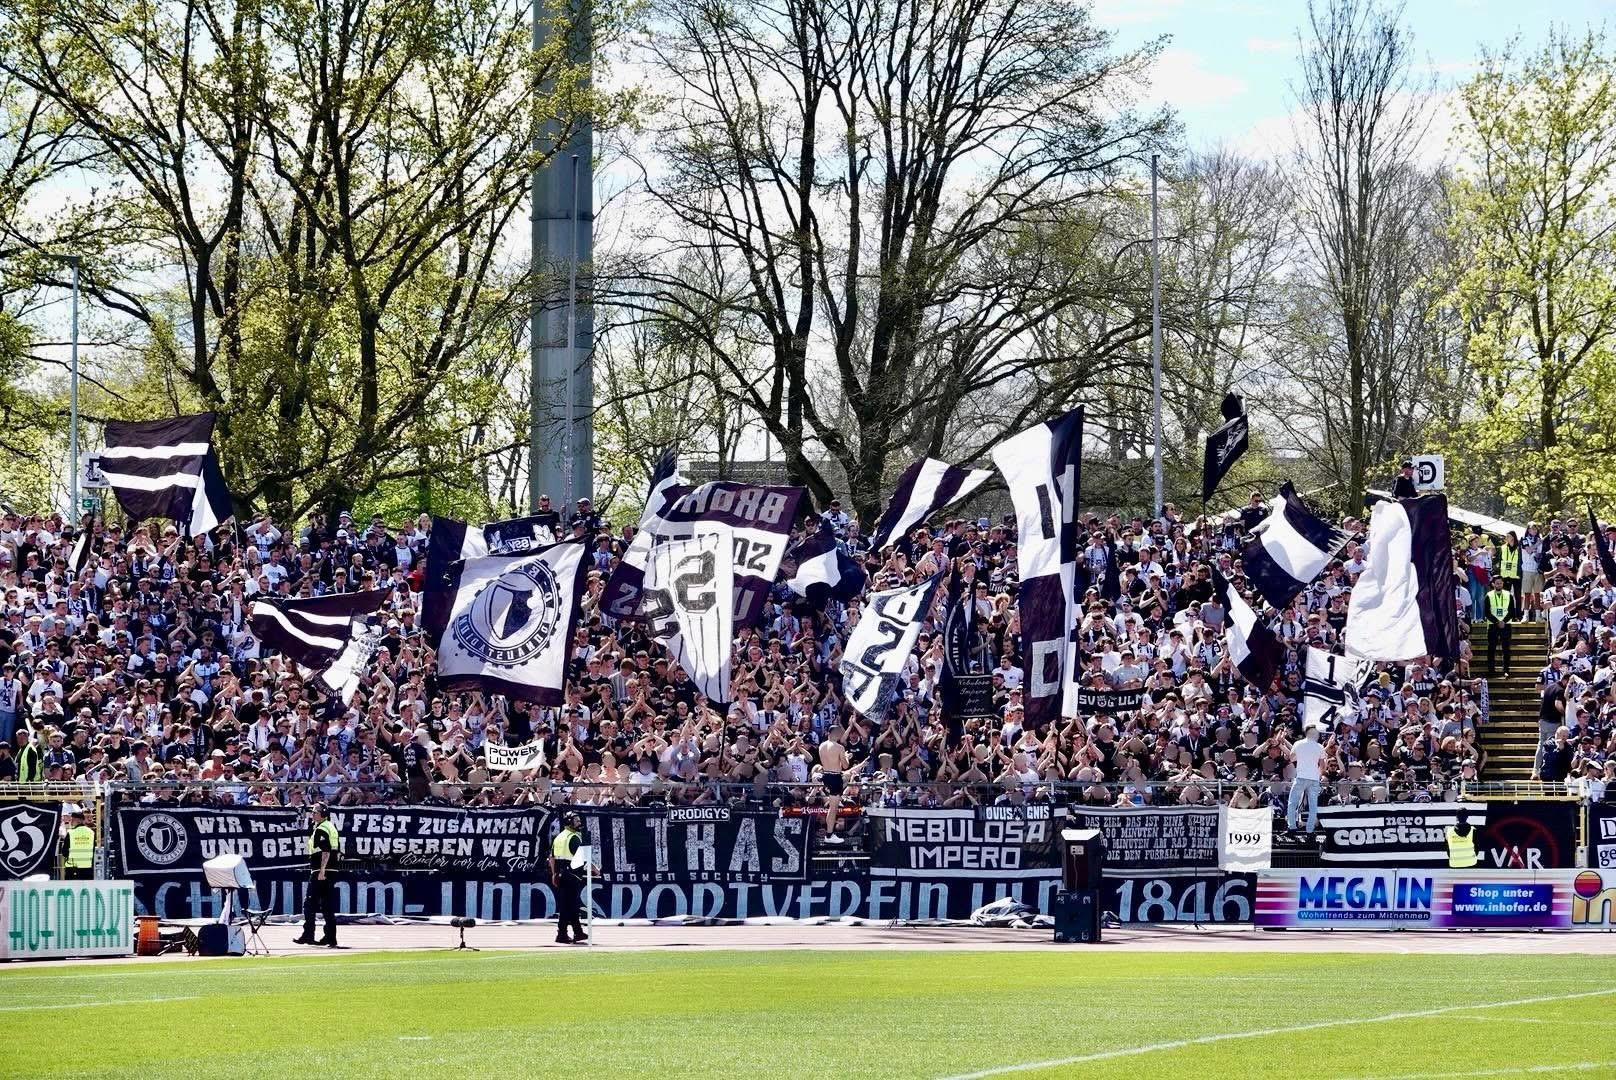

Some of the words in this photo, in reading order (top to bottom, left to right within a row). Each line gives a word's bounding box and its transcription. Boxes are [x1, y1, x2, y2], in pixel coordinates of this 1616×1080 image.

[489, 746, 538, 757] POWER
[489, 756, 519, 767] ULM
[670, 807, 730, 821] PRODIGYS
[194, 816, 243, 834] WIR
[352, 813, 412, 834] FEST
[418, 816, 535, 836] ZUSAMMEN
[1125, 816, 1142, 827] DAS
[1385, 816, 1424, 826] nero
[885, 819, 1046, 843] NEBULOSA
[1333, 826, 1447, 846] constan
[1228, 832, 1261, 845] 1999
[200, 838, 254, 859] UND
[356, 837, 475, 856] UNSEREN
[481, 838, 531, 858] WEG
[910, 845, 1021, 869] IMPERO
[1491, 846, 1544, 870] VAR
[690, 872, 768, 882] SOCIETY
[1469, 887, 1499, 900] Shop
[1503, 887, 1534, 899] unter
[1116, 879, 1250, 922] 1846
[1455, 901, 1548, 914] www.inhofer.de
[1300, 911, 1354, 920] Wohntrends
[1357, 912, 1376, 920] zum
[1379, 911, 1430, 920] Mitnehmen
